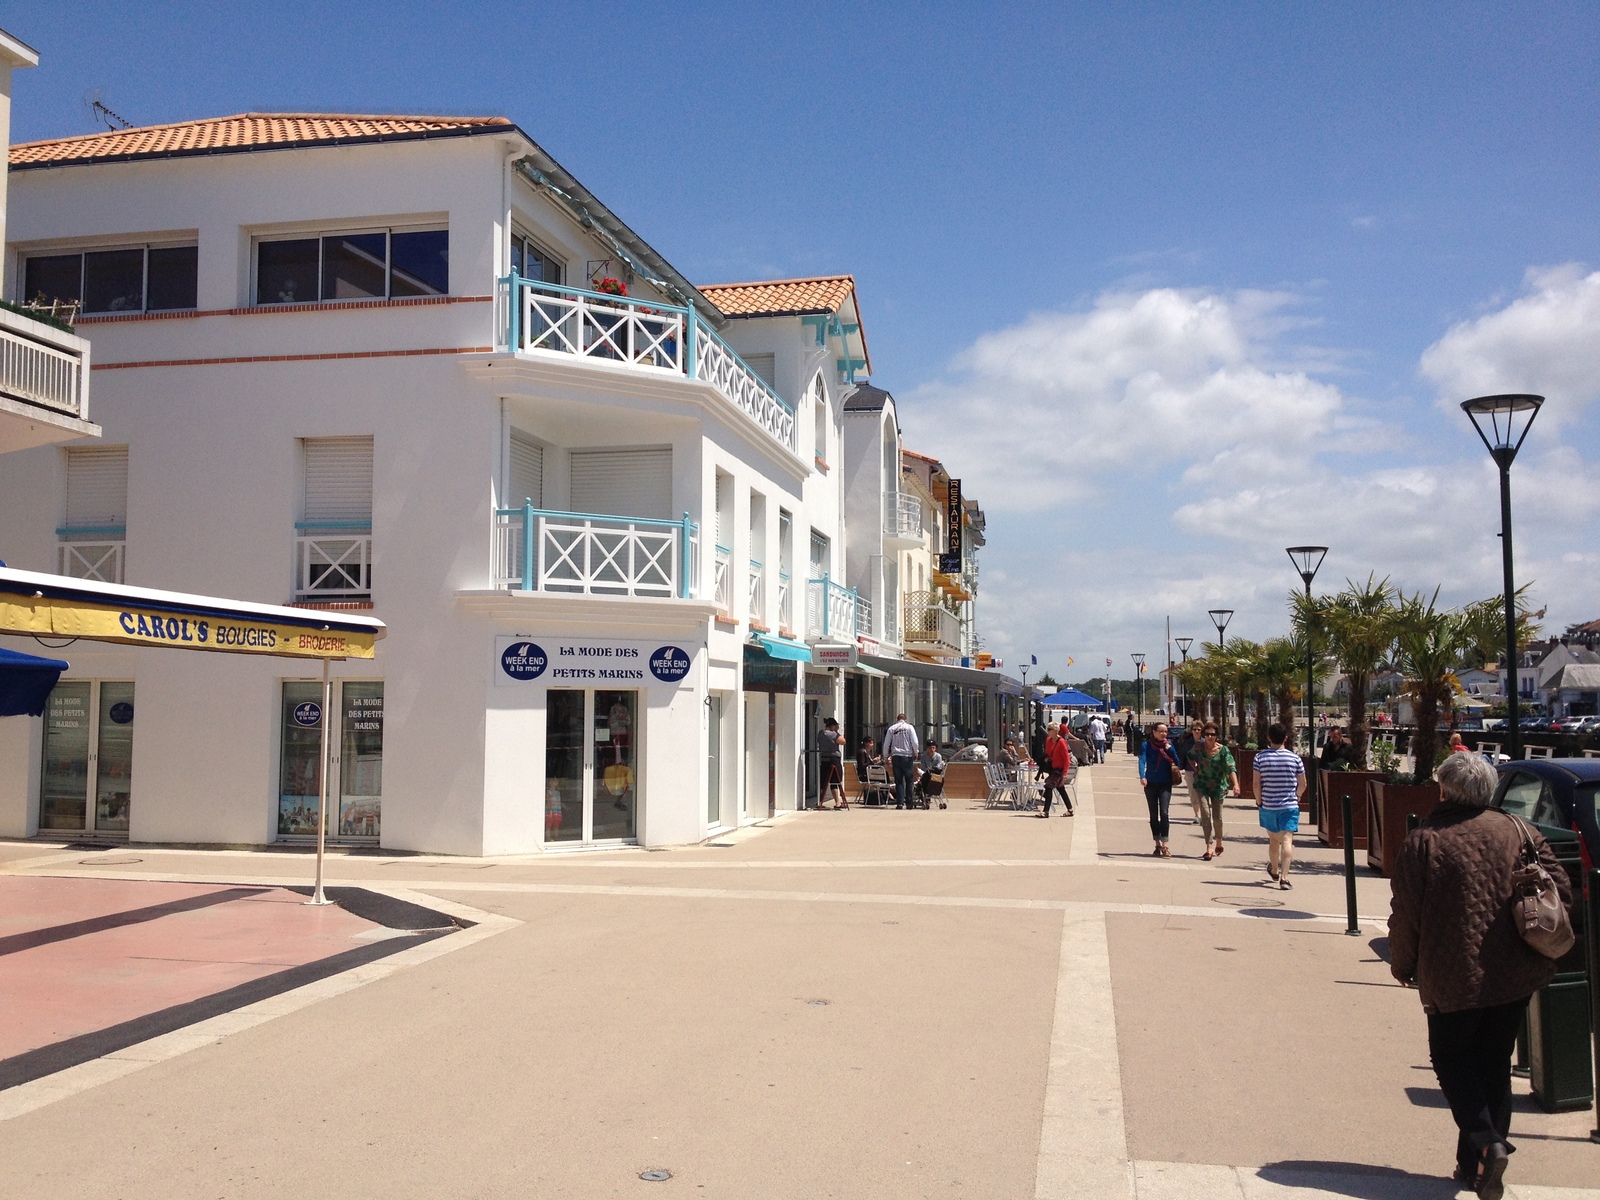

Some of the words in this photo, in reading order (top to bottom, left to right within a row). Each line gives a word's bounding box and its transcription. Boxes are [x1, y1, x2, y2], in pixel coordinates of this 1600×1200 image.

[951, 480, 959, 552] RESTAURANT
[119, 611, 209, 643] CAROL'S
[215, 625, 277, 648] BOUGIES
[298, 633, 346, 652] BRODERIE
[559, 646, 576, 656] LA
[578, 647, 613, 657] MODE
[616, 648, 639, 658] DES
[505, 656, 528, 665] WEEK
[529, 656, 545, 665] END
[652, 659, 673, 668] WEEK
[673, 659, 688, 668] END
[510, 664, 515, 672] à
[516, 664, 523, 672] la
[552, 668, 596, 679] PETITS
[598, 668, 644, 680] MARINS
[55, 720, 79, 728] MARINS
[354, 722, 380, 730] MARINS
